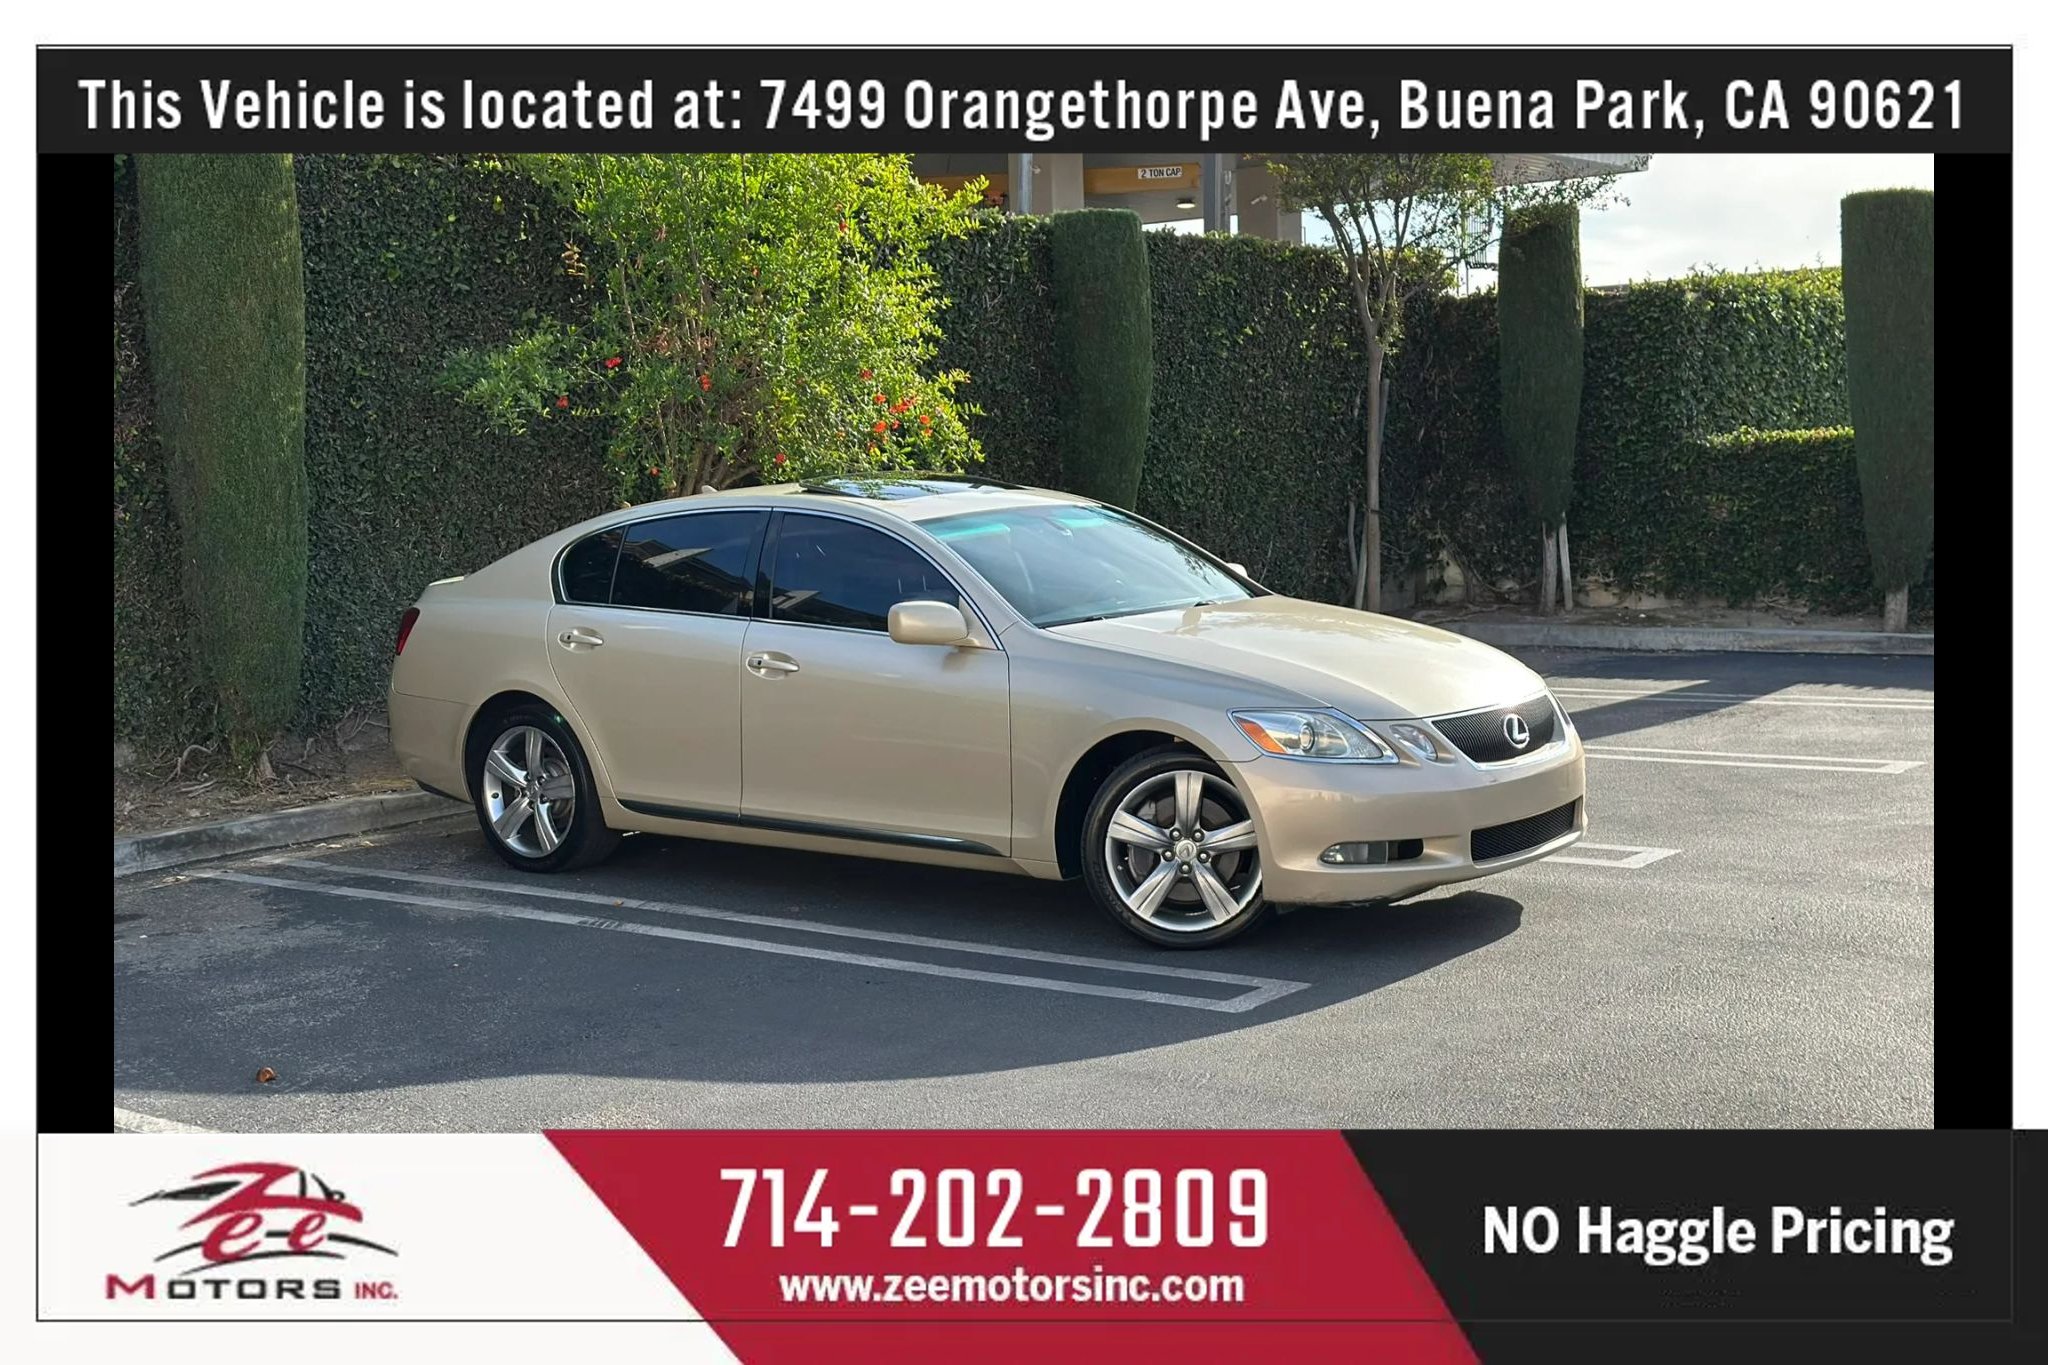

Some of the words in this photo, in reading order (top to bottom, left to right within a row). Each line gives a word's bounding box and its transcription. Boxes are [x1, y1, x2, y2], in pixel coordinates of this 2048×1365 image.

[1141, 168, 1147, 178] 2
[1149, 168, 1164, 177] TON
[1166, 167, 1181, 177] CAP
